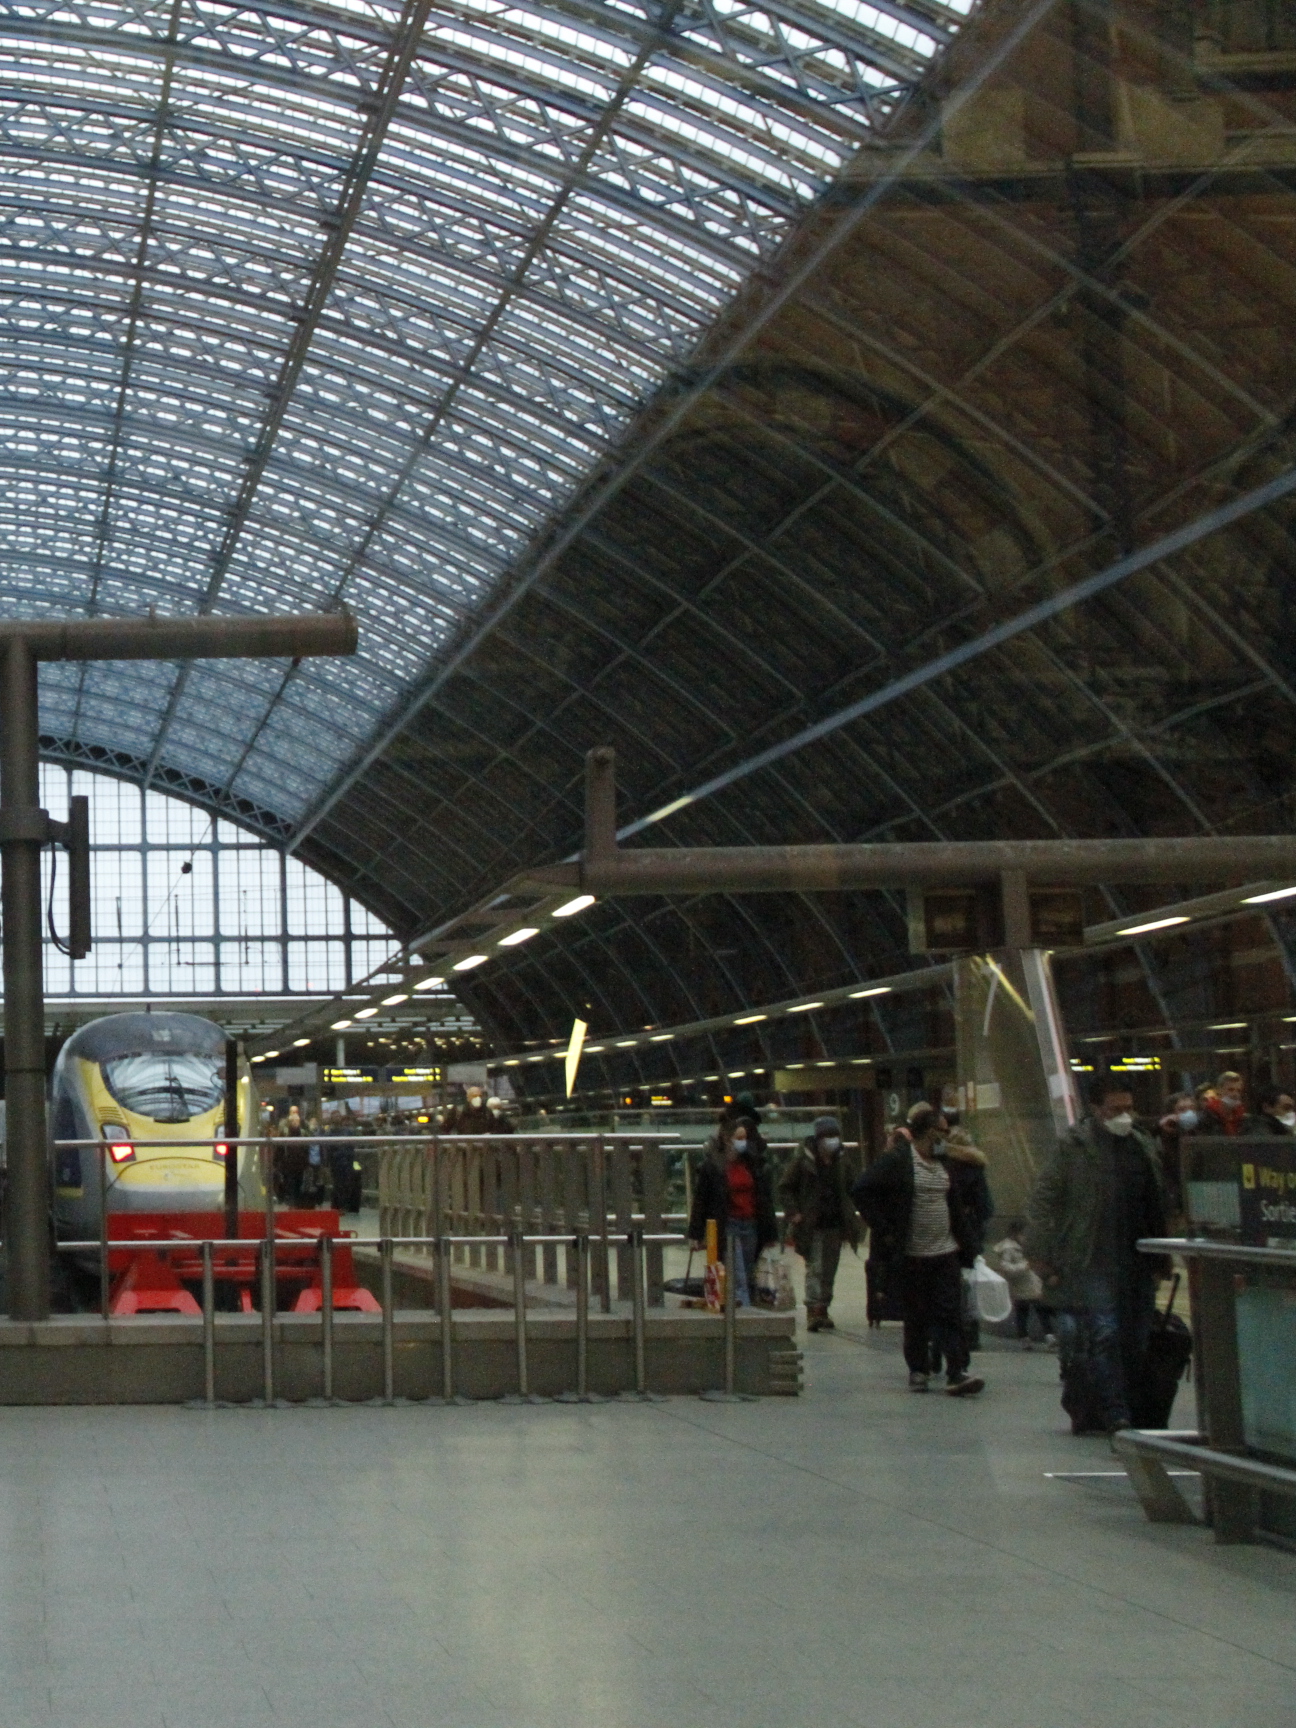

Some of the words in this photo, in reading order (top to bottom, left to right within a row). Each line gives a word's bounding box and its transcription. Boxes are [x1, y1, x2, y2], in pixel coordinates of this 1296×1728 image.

[889, 1093, 900, 1116] 9
[149, 1163, 201, 1171] EUROSTAR
[1259, 1166, 1285, 1195] Way
